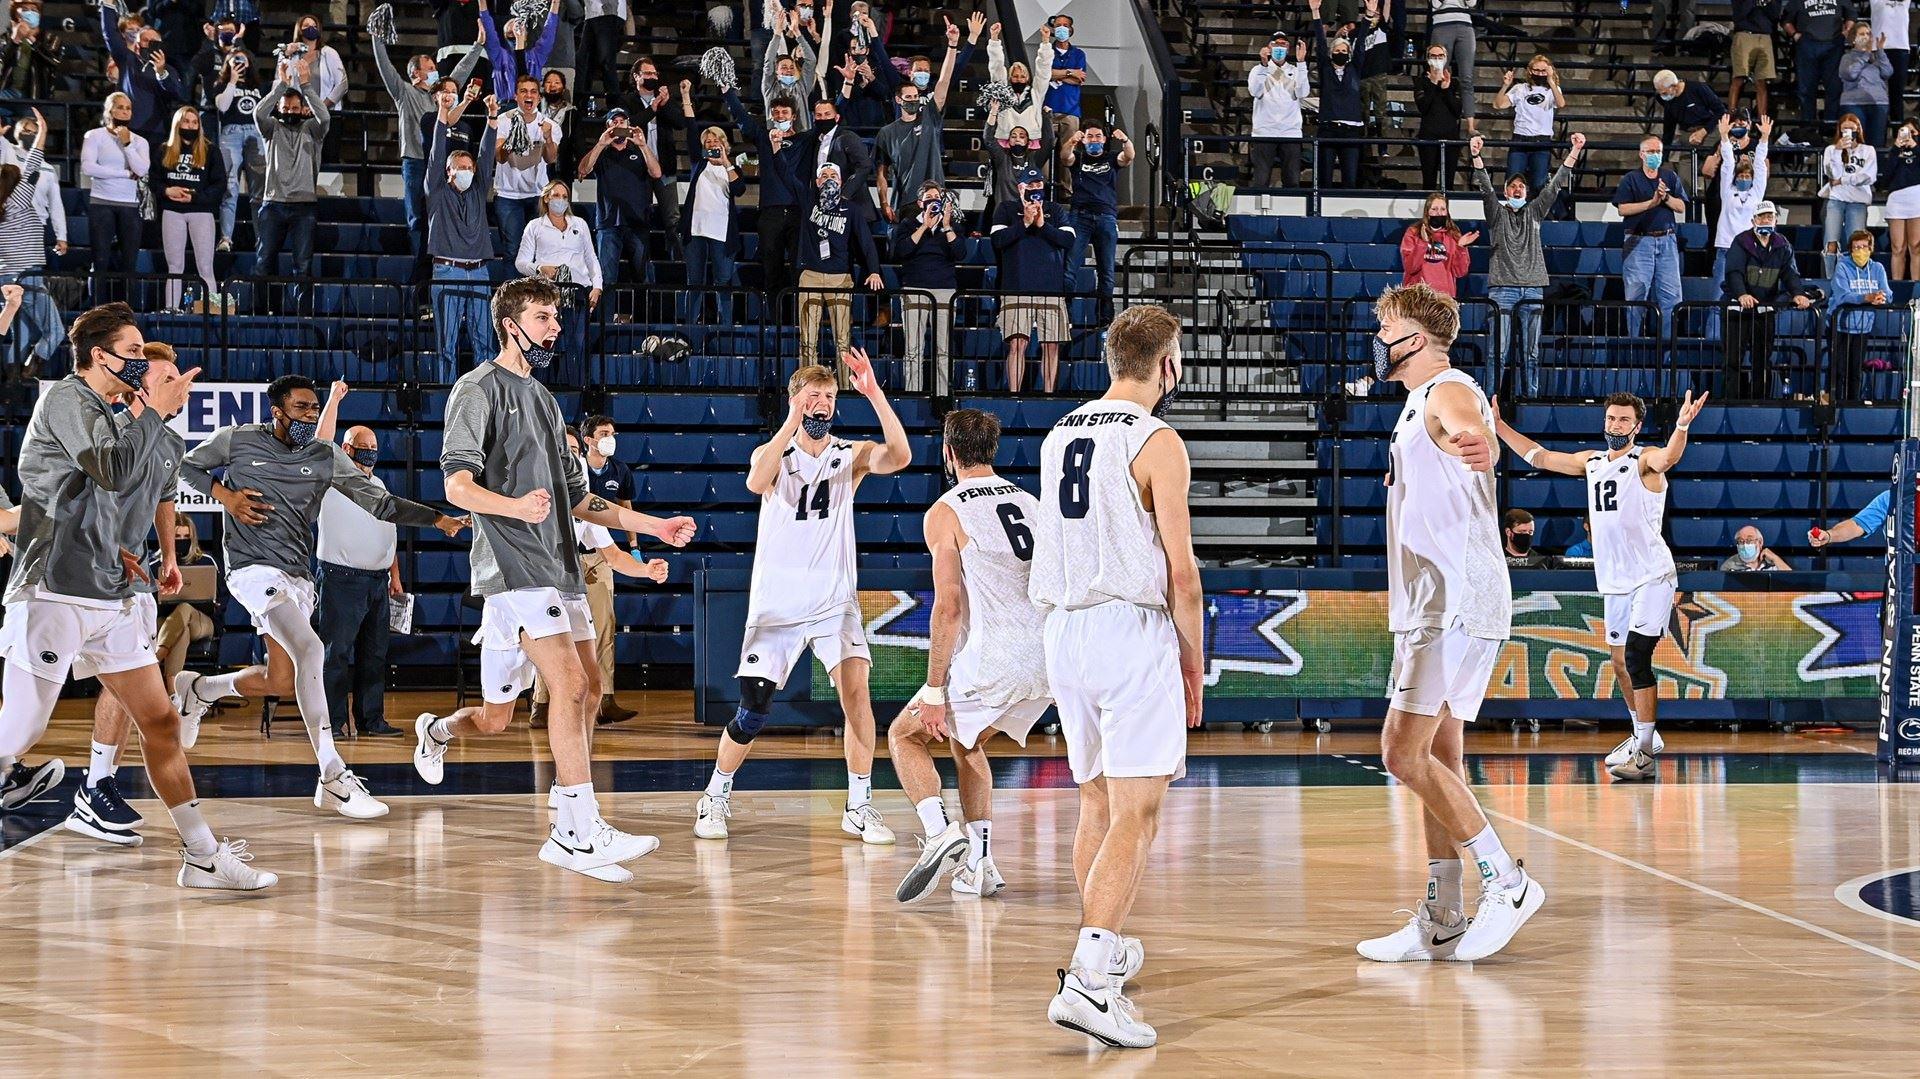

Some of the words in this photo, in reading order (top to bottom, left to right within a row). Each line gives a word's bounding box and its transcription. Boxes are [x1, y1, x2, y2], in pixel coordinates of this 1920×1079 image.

[62, 17, 75, 33] G
[1182, 110, 1192, 124] E
[971, 137, 981, 151] D
[1193, 140, 1204, 154] D
[1202, 166, 1214, 180] C
[1087, 411, 1140, 427] STATE
[1059, 438, 1096, 519] 8
[795, 479, 830, 521] 14
[957, 485, 996, 503] PENN
[993, 484, 1023, 495] STA
[1594, 480, 1618, 512] 12
[995, 502, 1035, 562] 6
[1911, 624, 1920, 663] PENN
[1878, 638, 1893, 743] PENN
[1898, 747, 1911, 756] REC
